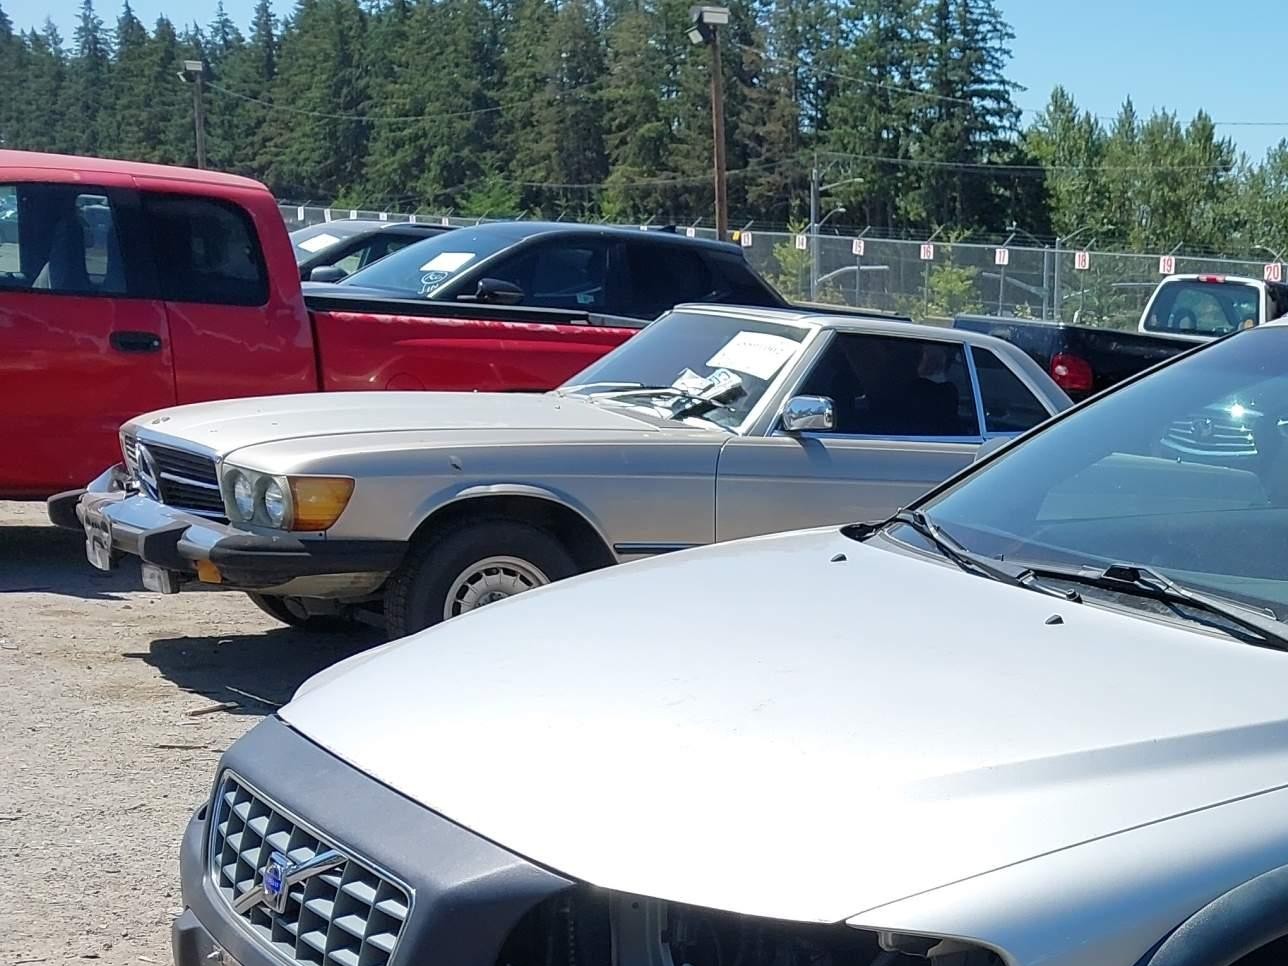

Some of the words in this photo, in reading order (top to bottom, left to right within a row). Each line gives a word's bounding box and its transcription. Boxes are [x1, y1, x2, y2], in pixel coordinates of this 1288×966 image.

[854, 240, 863, 254] 15
[923, 245, 932, 258] 16
[998, 249, 1006, 262] 17
[1077, 253, 1087, 268] 18
[1162, 256, 1173, 272] 19
[1265, 264, 1280, 280] 20
